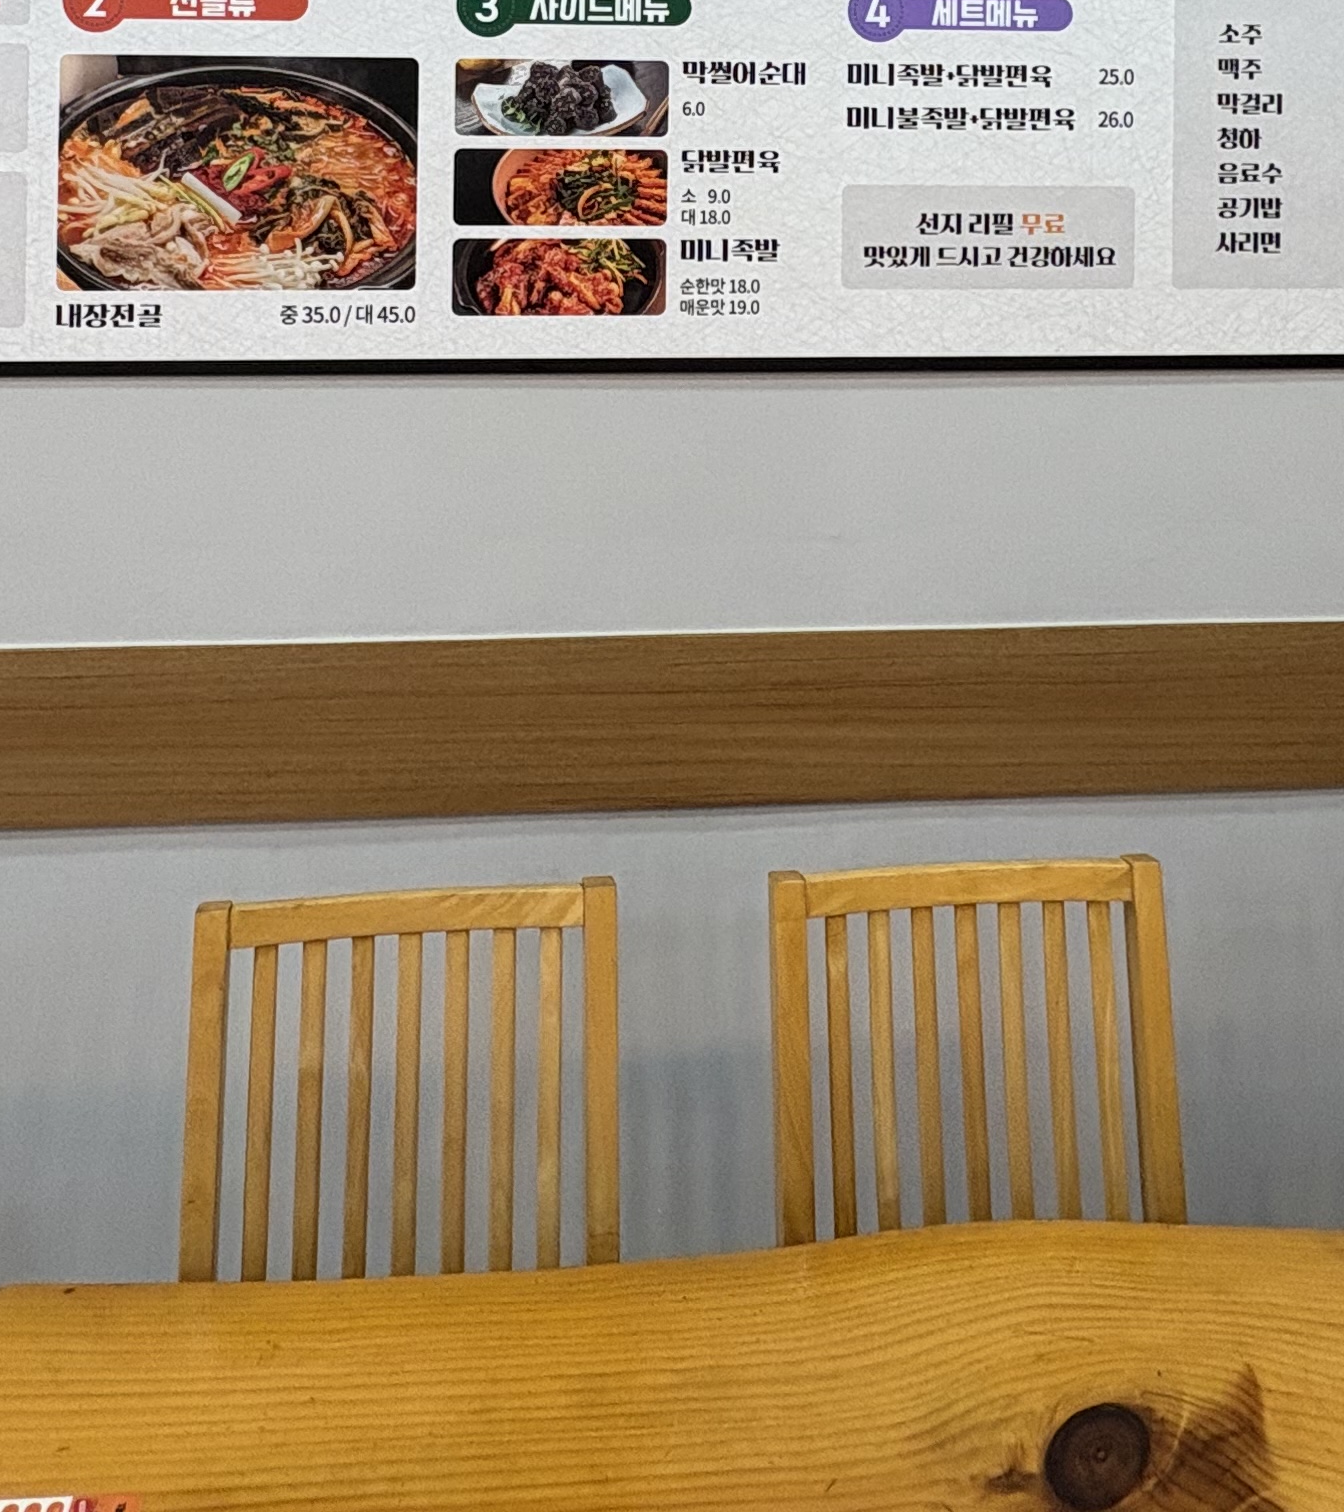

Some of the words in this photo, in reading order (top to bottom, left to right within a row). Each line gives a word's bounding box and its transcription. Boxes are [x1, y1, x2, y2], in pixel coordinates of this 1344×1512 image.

[1219, 23, 1262, 46] 소주
[682, 60, 806, 86] 막썰어순대
[1098, 67, 1135, 86] 25.0
[1218, 58, 1262, 81] 맥주
[682, 100, 706, 117] 6.0
[1217, 92, 1283, 115] 막걸리
[1098, 110, 1134, 129] 26.0
[1217, 127, 1262, 150] 청하
[681, 149, 780, 174] 닭발편육
[1217, 162, 1283, 185] 음료수
[680, 188, 697, 203] 소
[707, 188, 731, 205] 9.0
[1218, 197, 1283, 219] 공기밥
[681, 208, 696, 227] 대
[699, 209, 731, 225] 18.0
[916, 212, 962, 236] 선지
[968, 212, 1014, 236] 리필
[1019, 213, 1066, 236] 무료
[680, 238, 781, 263] 미니족발
[1215, 231, 1281, 254] 사리면
[863, 245, 931, 268] 맛있게
[937, 246, 1001, 268] 드시고
[1007, 246, 1116, 268] 건강하세요
[679, 277, 726, 296] 순한맛
[728, 278, 761, 294] 18.0
[55, 303, 163, 329] 내장전골
[279, 304, 299, 326] 중
[301, 305, 341, 324] 35.0
[355, 303, 374, 325] 대
[376, 305, 416, 324] 45.0
[679, 298, 726, 317] 매운맛
[728, 299, 760, 316] 19.0
